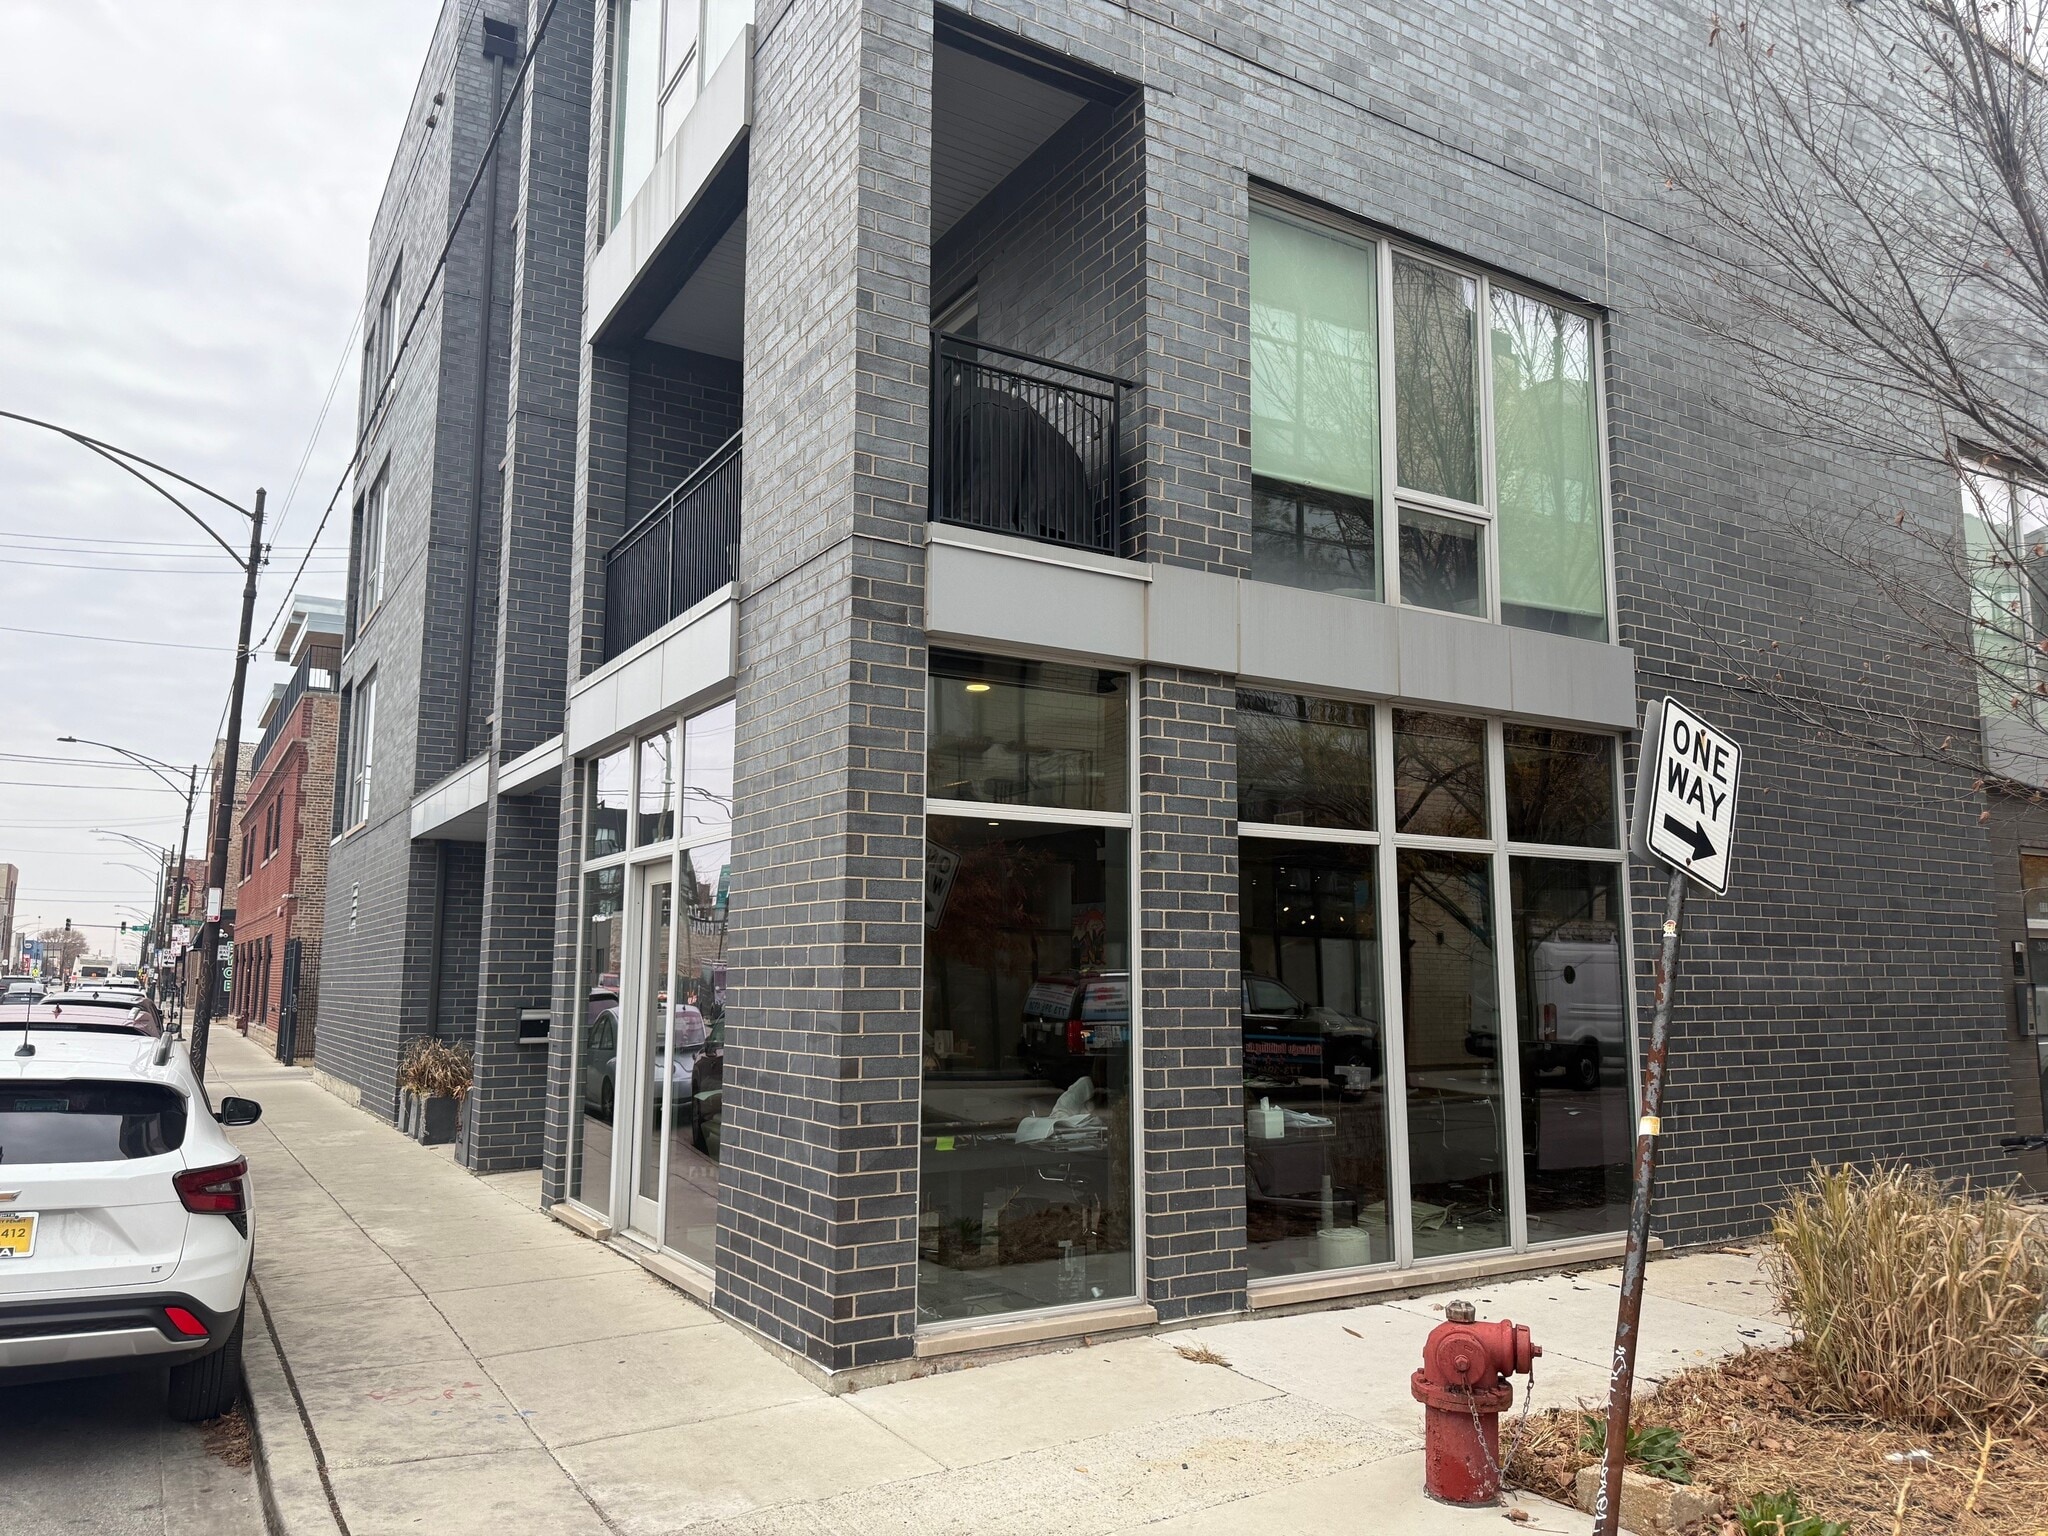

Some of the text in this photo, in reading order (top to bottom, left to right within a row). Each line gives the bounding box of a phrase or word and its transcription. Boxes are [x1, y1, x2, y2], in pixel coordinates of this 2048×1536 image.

[1673, 720, 1729, 784] ONE
[1668, 757, 1727, 822] WAY
[1, 1228, 26, 1238] 412
